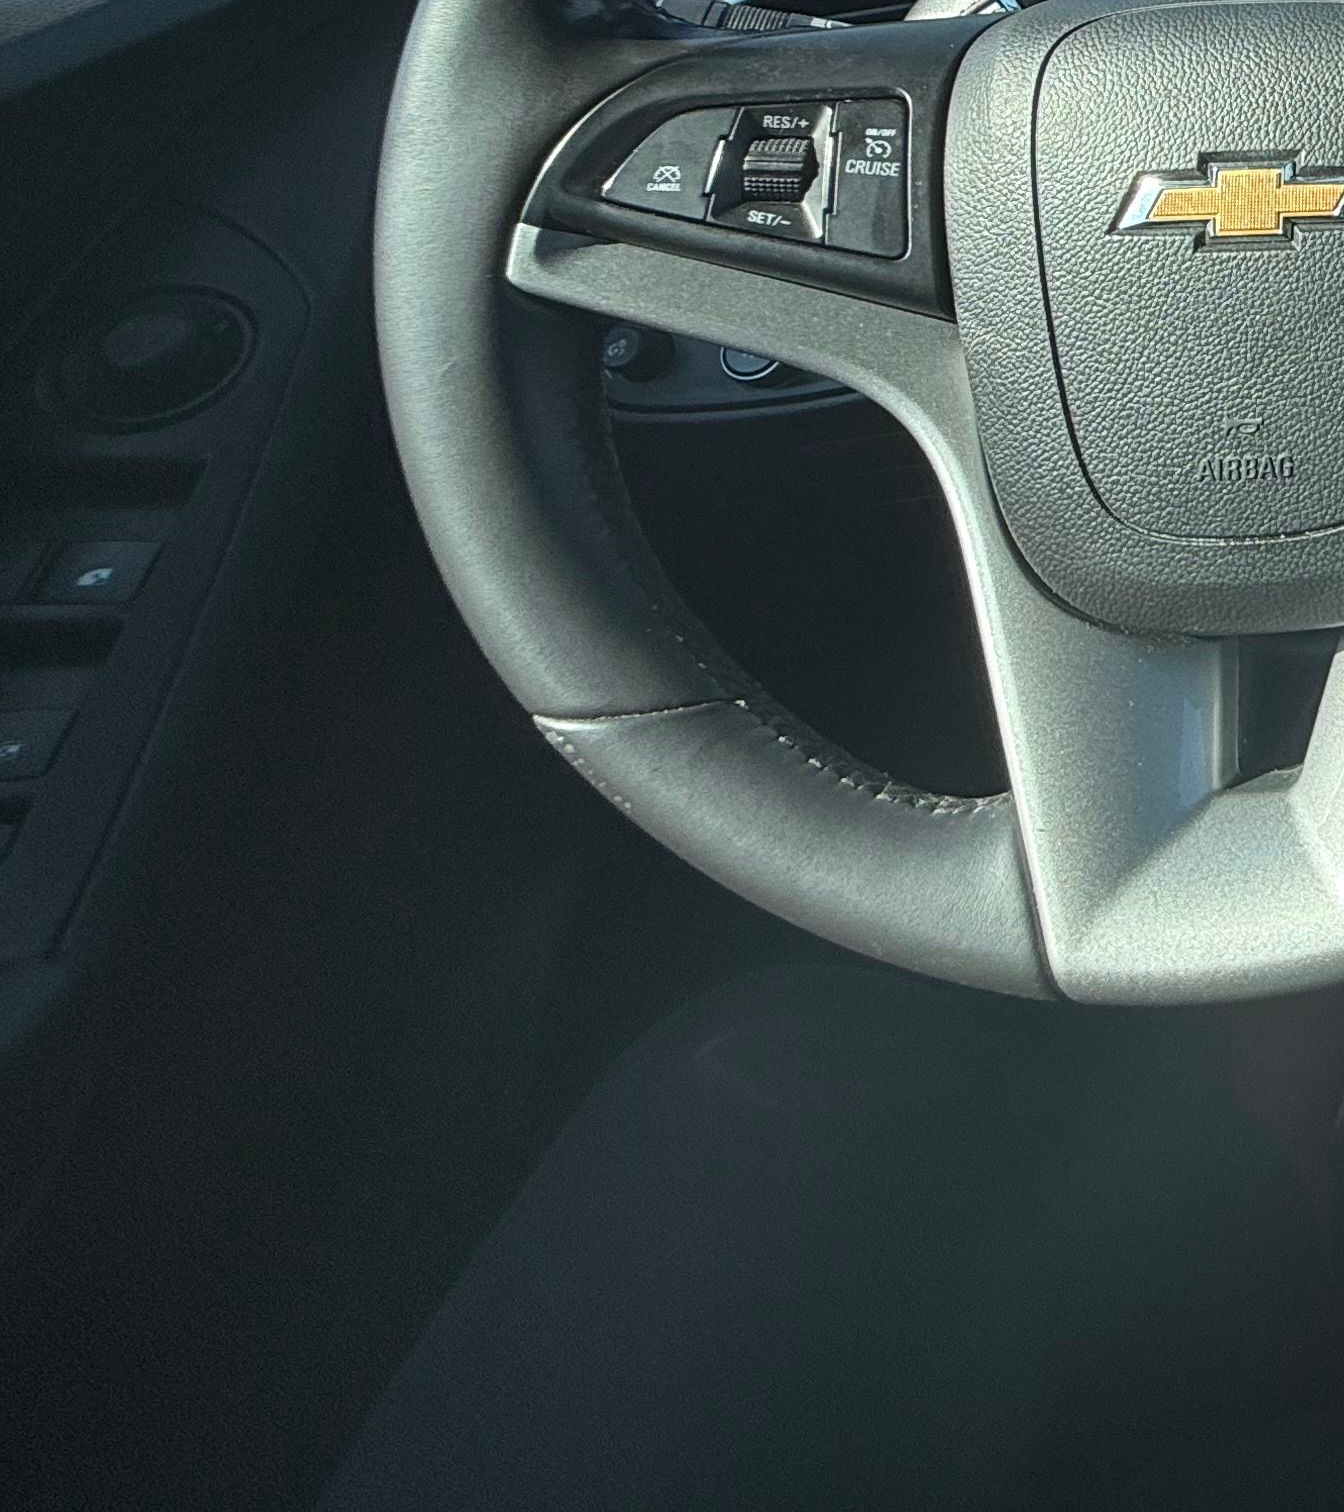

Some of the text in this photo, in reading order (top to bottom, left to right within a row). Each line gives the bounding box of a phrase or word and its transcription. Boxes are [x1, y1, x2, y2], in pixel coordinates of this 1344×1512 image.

[844, 159, 901, 178] CRUISE
[646, 182, 681, 193] CANCEL
[1200, 454, 1295, 483] AIRBAG
